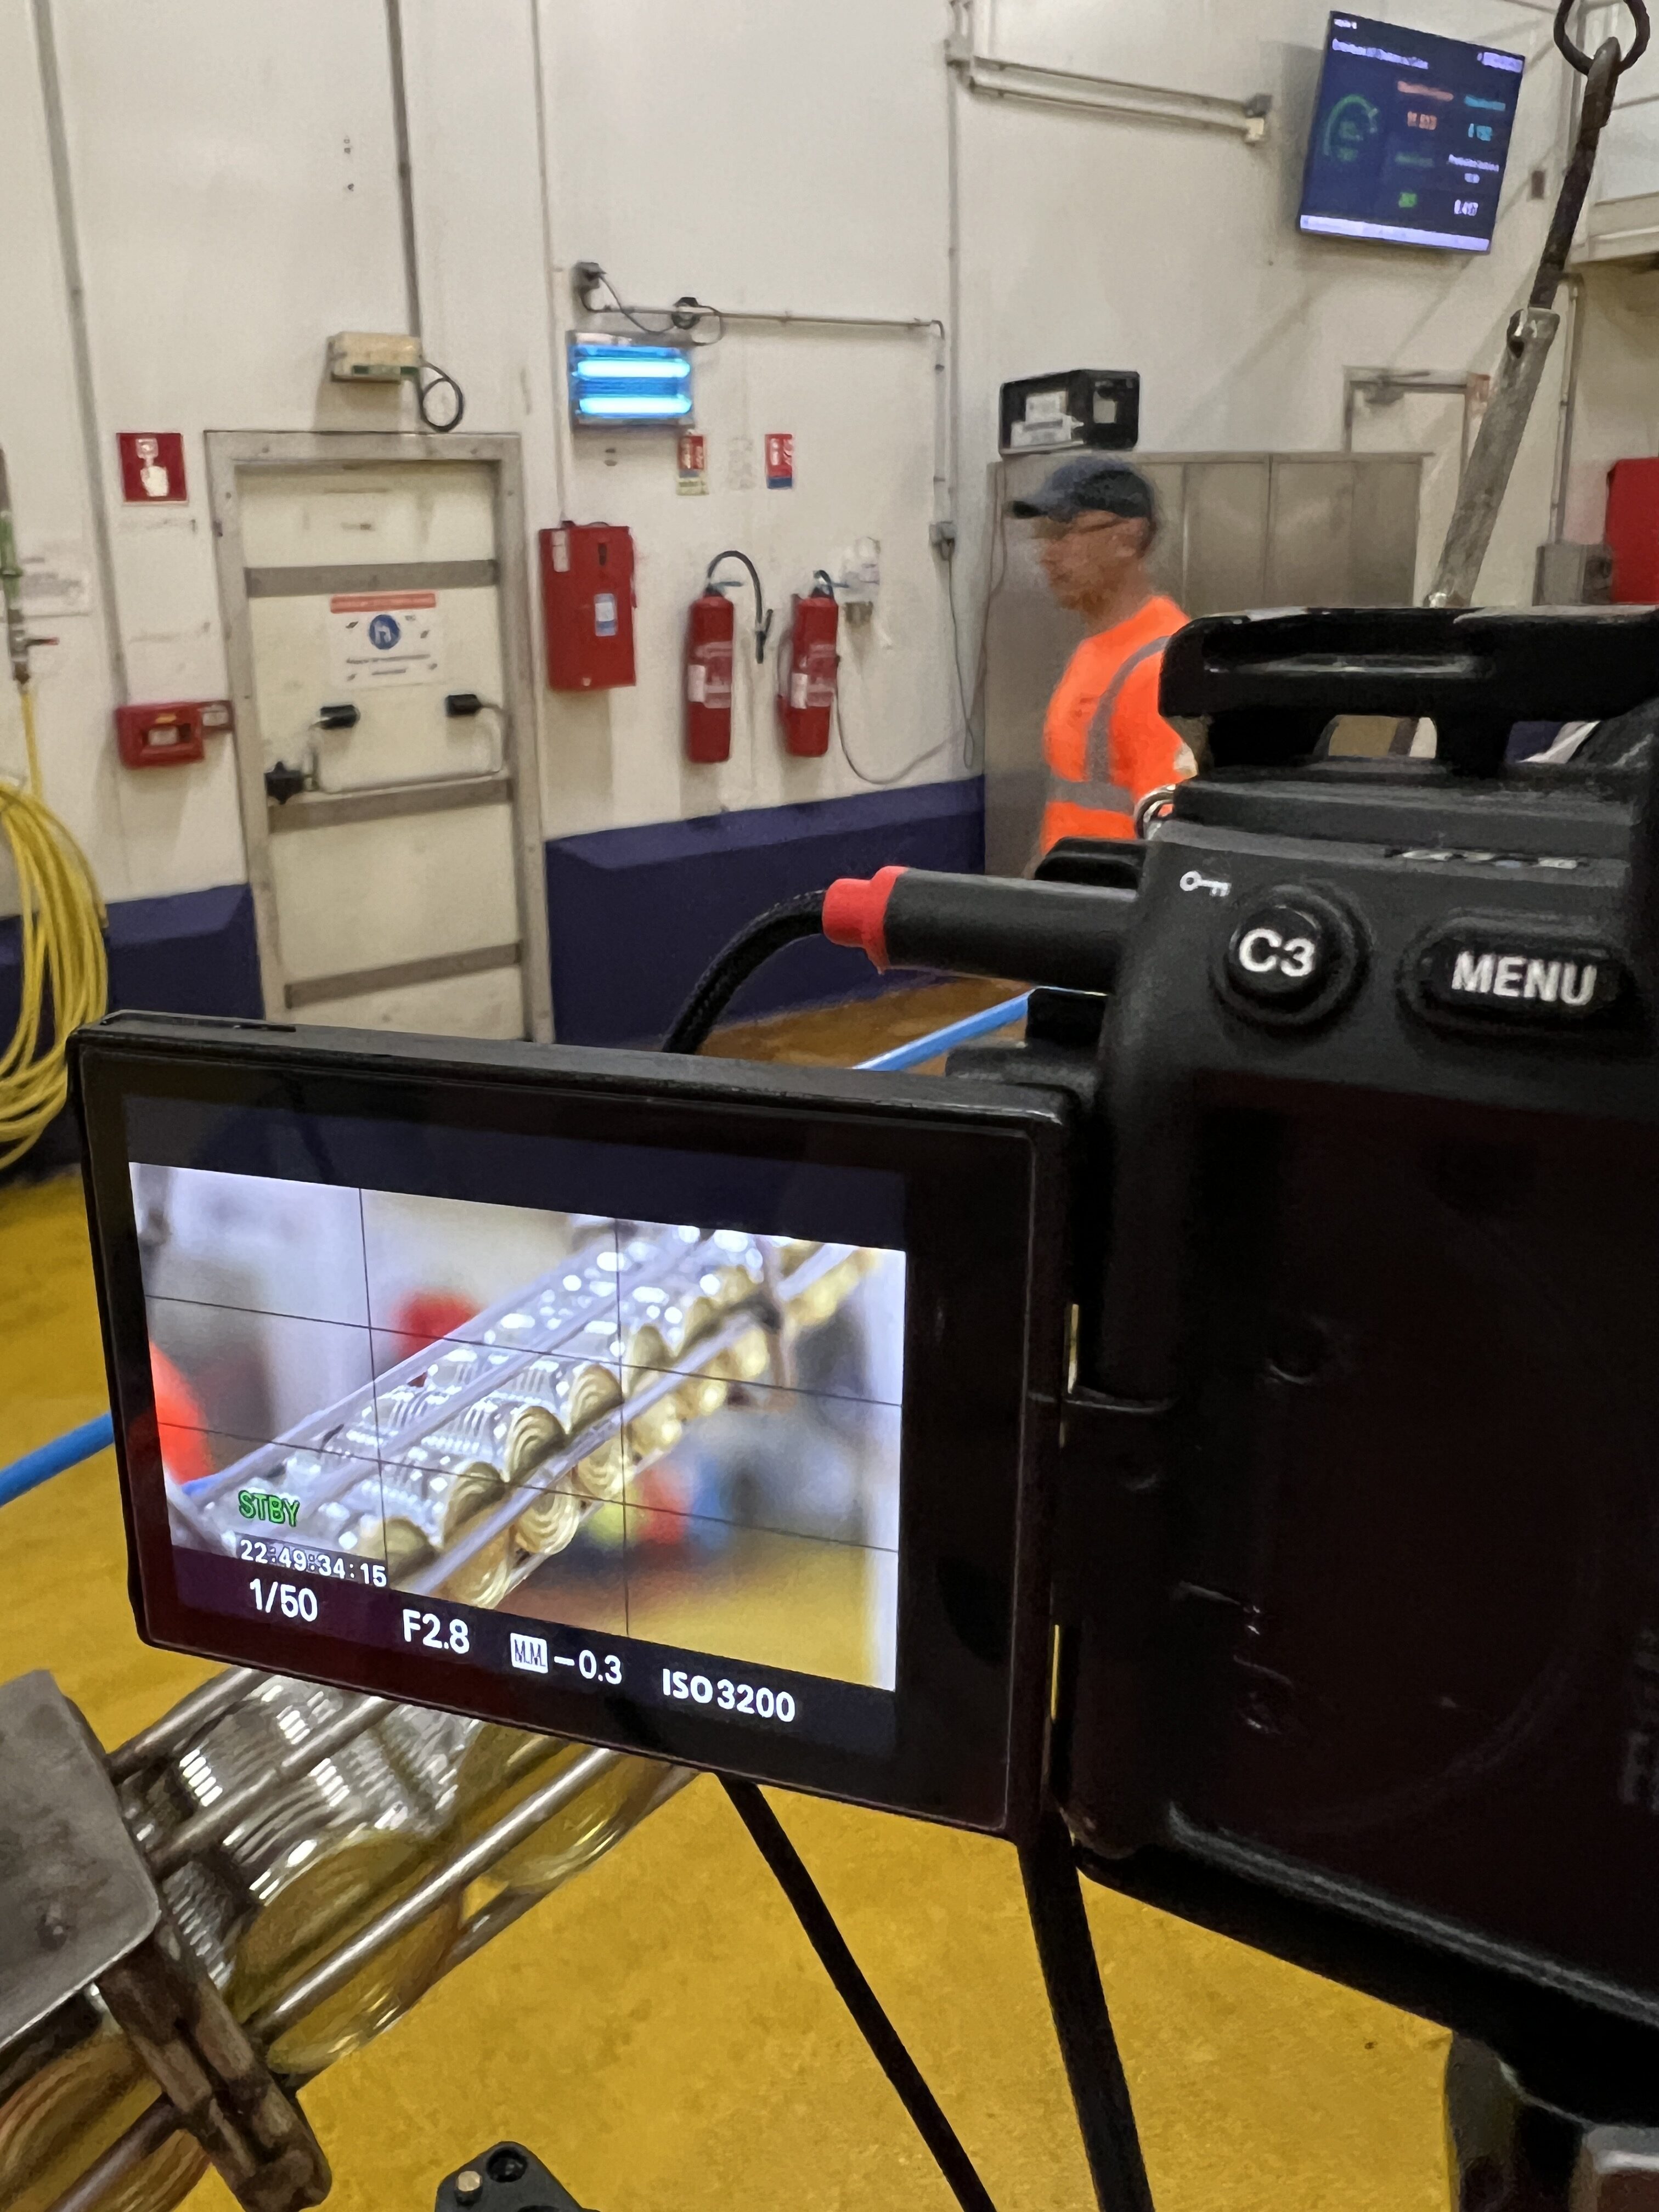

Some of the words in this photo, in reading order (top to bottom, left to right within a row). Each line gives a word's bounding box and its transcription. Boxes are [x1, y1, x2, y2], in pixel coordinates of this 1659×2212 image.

[1238, 928, 1316, 978] C3
[1451, 950, 1598, 1006] MENU
[238, 1490, 300, 1527] STBY
[240, 1539, 387, 1587] 22:49:34:15
[250, 1578, 318, 1622] 1/50
[403, 1609, 470, 1654] F2.8
